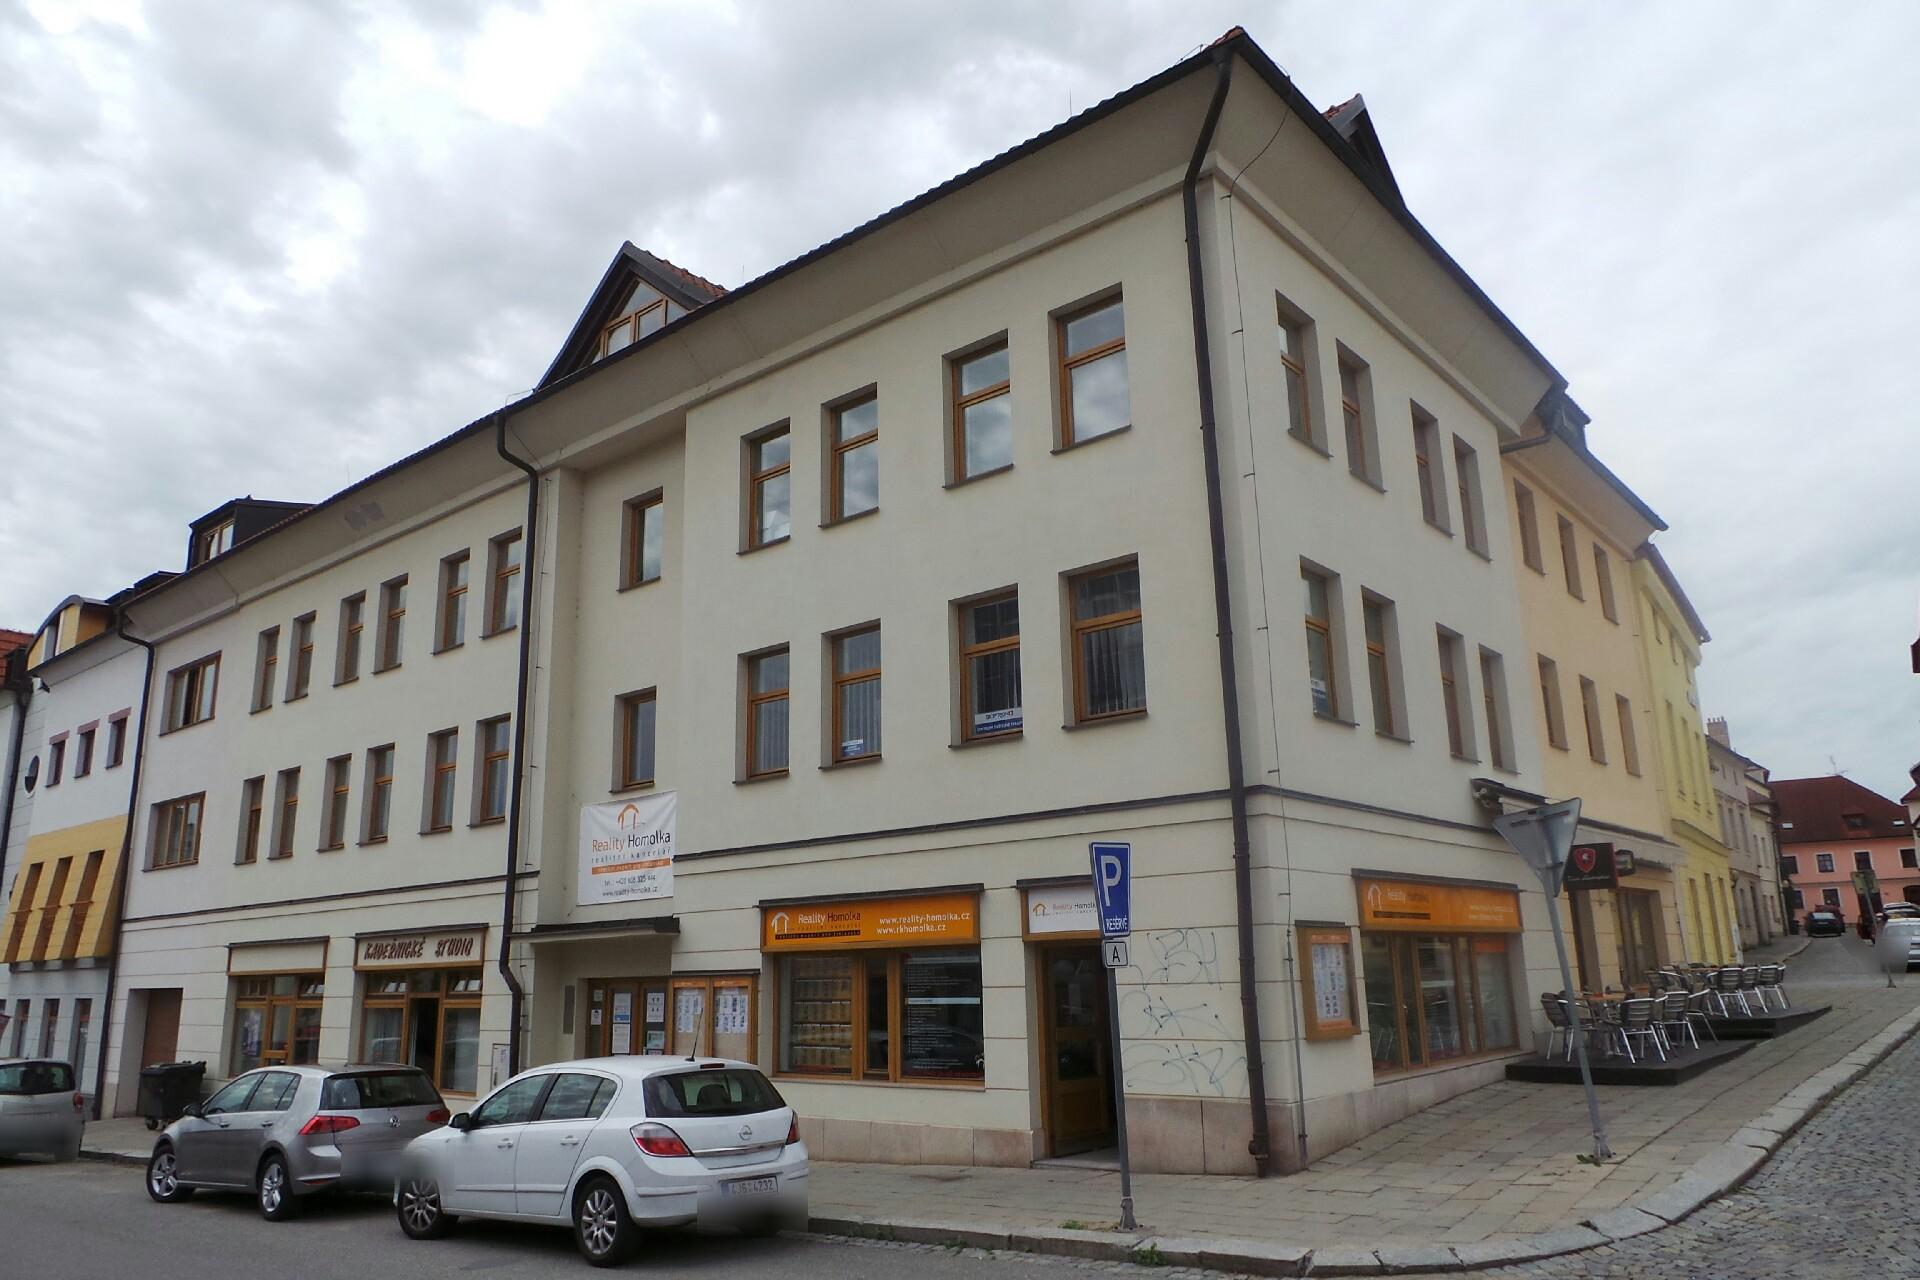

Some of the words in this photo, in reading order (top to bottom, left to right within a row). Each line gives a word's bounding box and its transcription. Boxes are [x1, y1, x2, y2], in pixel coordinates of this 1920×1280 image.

[592, 836, 625, 853] Reality
[627, 830, 671, 848] Homolka
[1100, 855, 1122, 907] P
[1074, 900, 1097, 910] Homolk
[798, 914, 825, 926] Reality
[827, 911, 861, 923] Homolka
[879, 912, 970, 925] www.reality-homolka.cz
[876, 923, 947, 935] www.rkhomolka.cz
[434, 938, 474, 957] STUDIO
[1111, 945, 1121, 963] A
